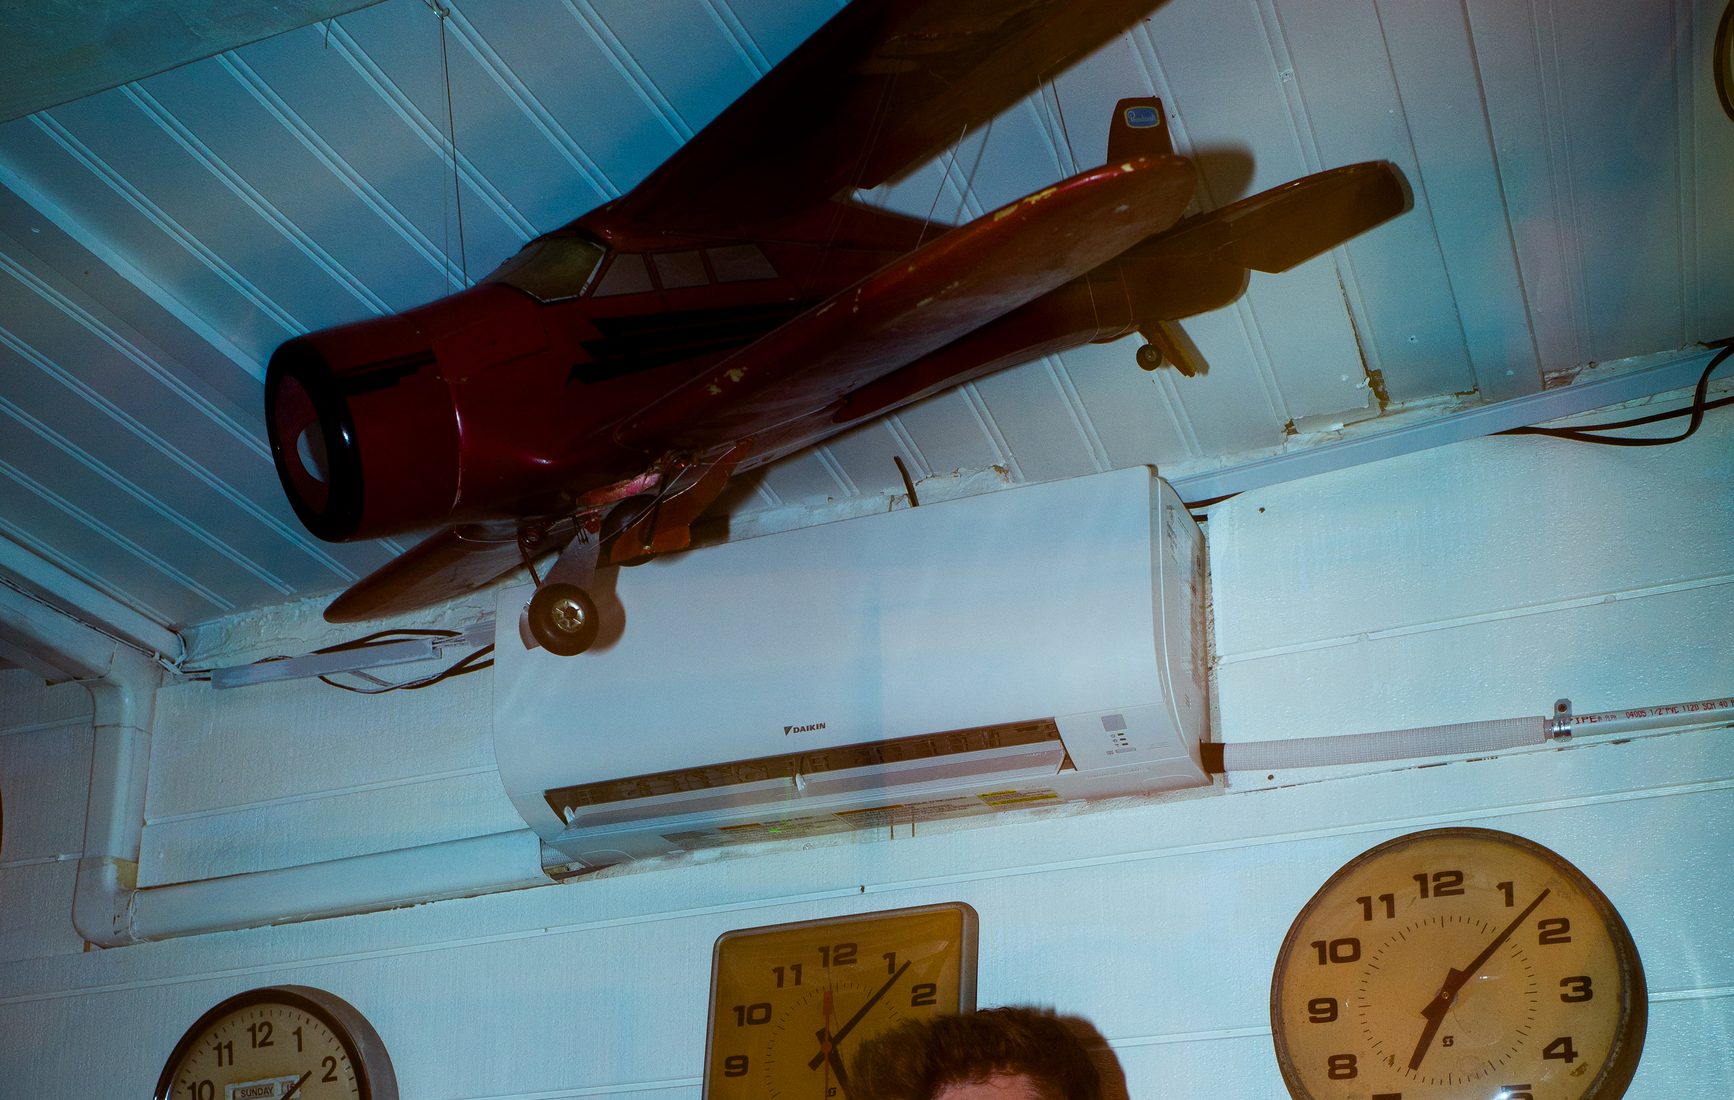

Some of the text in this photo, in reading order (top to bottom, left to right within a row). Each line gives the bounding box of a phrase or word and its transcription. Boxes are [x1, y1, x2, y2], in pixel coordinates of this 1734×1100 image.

[1703, 702, 1717, 710] SCH
[793, 722, 826, 733] DAIKIN
[1569, 715, 1598, 724] IPE
[1412, 870, 1465, 898] 12
[1496, 881, 1514, 907] 1
[1355, 893, 1396, 921] 11
[1537, 917, 1571, 945] 2
[818, 942, 857, 968] 12
[883, 952, 896, 974] 1
[1310, 937, 1361, 965] 10
[773, 964, 802, 988] 11
[1560, 975, 1593, 1003] 3
[911, 983, 937, 1007] 2
[733, 1002, 772, 1027] 10
[1308, 997, 1338, 1023] 9
[247, 1021, 274, 1048] 12
[292, 1027, 303, 1052] 1
[213, 1040, 234, 1067] 11
[1542, 1037, 1578, 1063] 4
[321, 1056, 338, 1083] 2
[724, 1055, 749, 1077] 9
[1328, 1054, 1358, 1080] 8
[240, 1085, 274, 1098] SUNDAY
